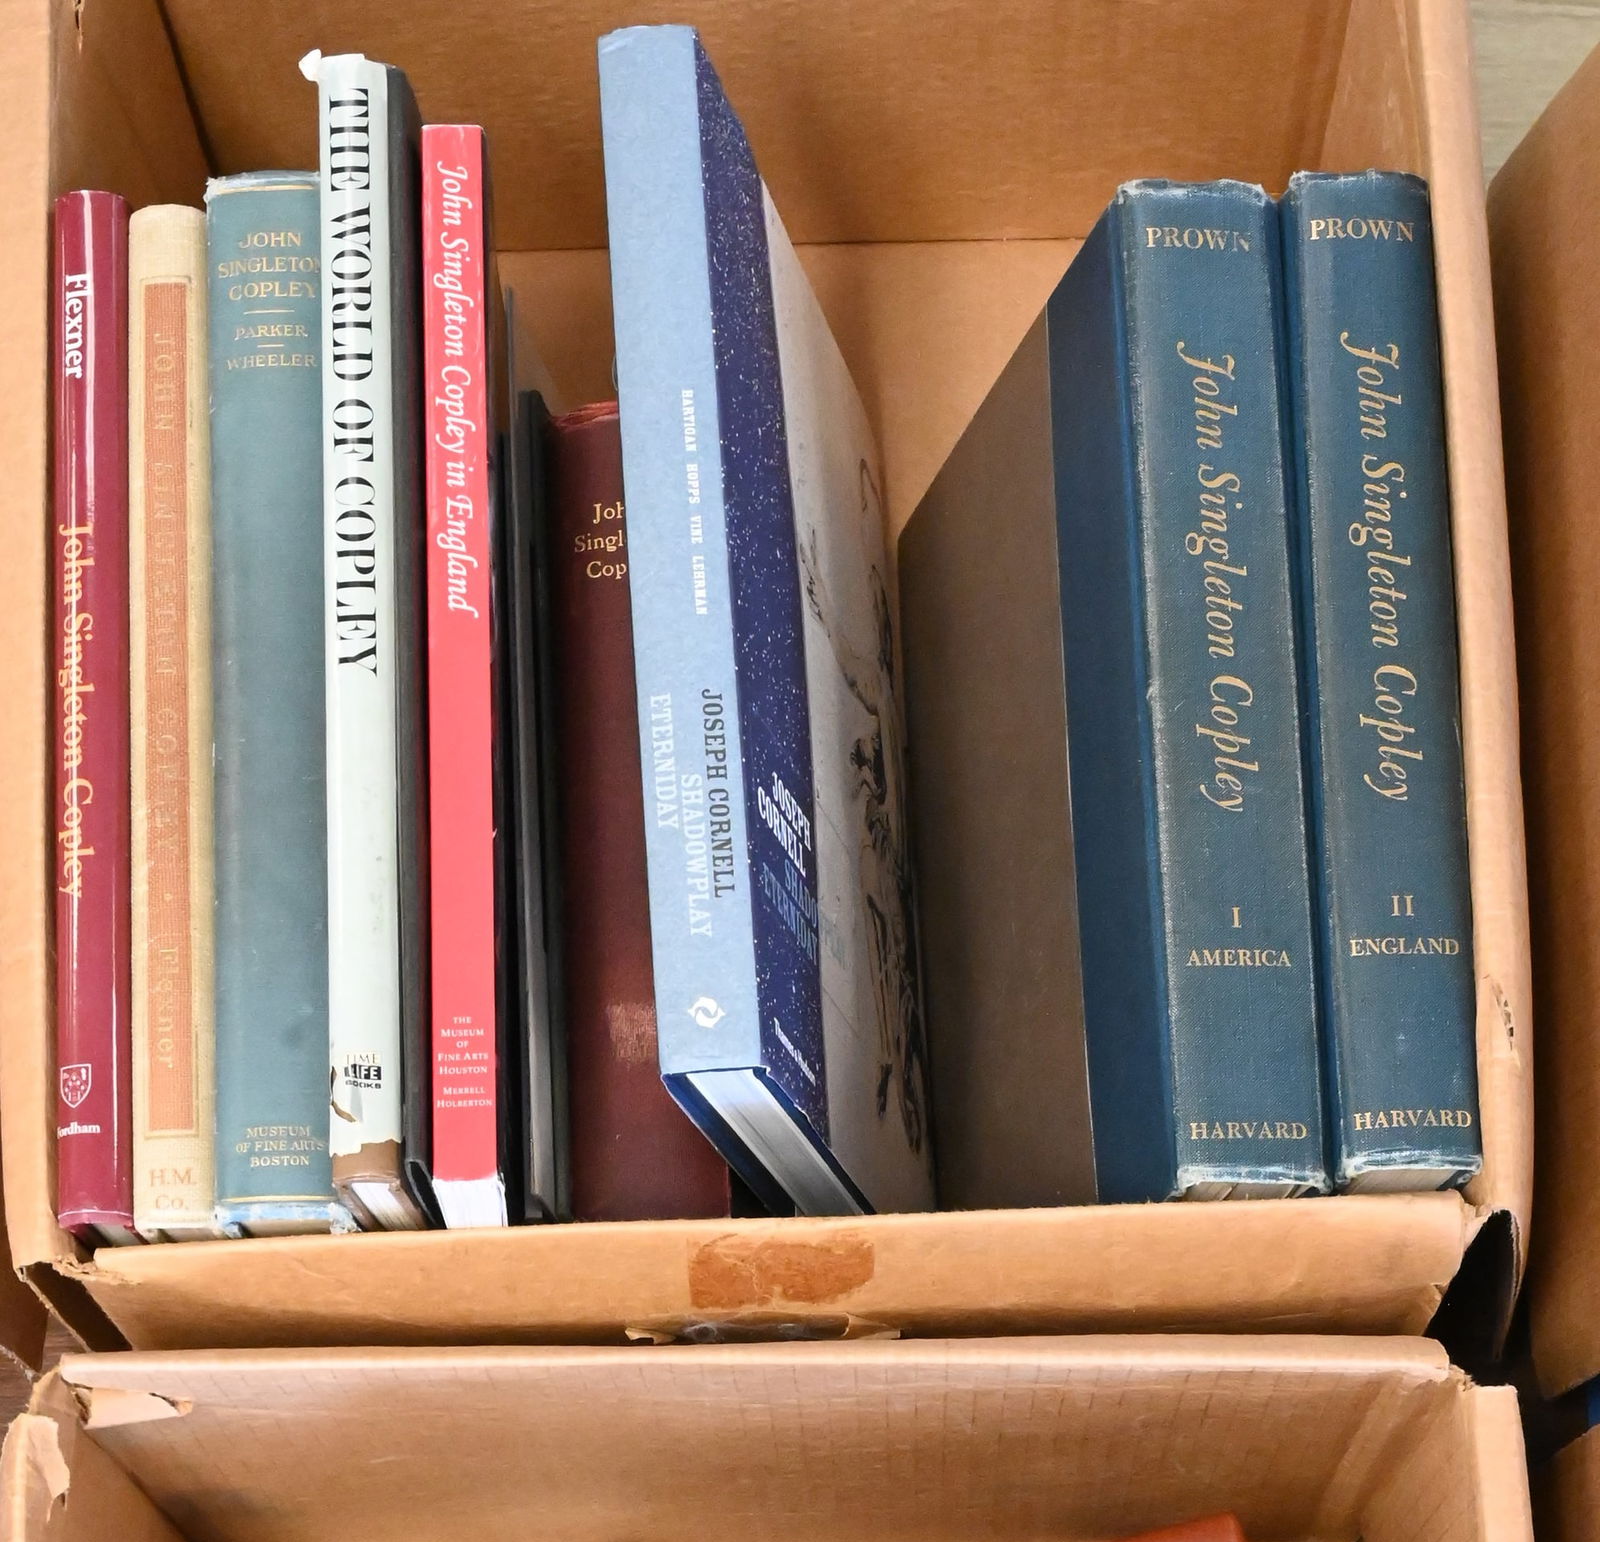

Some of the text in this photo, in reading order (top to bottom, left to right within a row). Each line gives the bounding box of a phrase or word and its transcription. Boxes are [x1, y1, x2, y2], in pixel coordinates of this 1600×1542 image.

[238, 232, 301, 249] JOHN
[1145, 226, 1251, 253] PROWN
[1309, 217, 1415, 243] PROWN
[229, 281, 316, 300] COPLEY
[65, 273, 92, 379] Flexner
[234, 325, 308, 341] PARKER
[227, 354, 317, 370] WHEELER
[328, 87, 378, 677] THE WORLD OF COPLEY
[433, 160, 478, 618] John Singleton Copley in England
[681, 389, 708, 615] HARTIGAN HOPPS VINE LEHRMAN
[593, 502, 625, 525] Joh
[574, 530, 625, 552] Singl
[586, 561, 627, 580] Cop
[1175, 340, 1260, 812] John Singleton Copley
[1339, 331, 1425, 802] John Singleton Copley
[58, 525, 95, 898] John Singleton Copley
[650, 693, 679, 829] ETERNIDAY
[701, 689, 735, 898] JOSEPH CORNELL
[772, 771, 812, 851] JOSEPH
[757, 786, 806, 877] CORNELL
[681, 774, 712, 937] SHADOWPLAY
[762, 862, 818, 966] ETERNIDAY
[1391, 894, 1415, 918] II
[1231, 906, 1242, 929] I
[1349, 937, 1461, 958] ENGLAND
[1185, 949, 1292, 968] AMERICA
[158, 948, 181, 1068] Flexner
[453, 1016, 472, 1024] THE
[440, 1028, 485, 1037] MUSEUM
[456, 1040, 470, 1048] OF
[437, 1052, 489, 1061] FINE ARTS
[344, 1064, 381, 1081] LIFE
[439, 1066, 488, 1075] HOUSTON
[345, 1079, 381, 1089] BOOKS
[442, 1086, 486, 1096] MERRELL
[436, 1099, 493, 1108] HOLBERTON
[1353, 1110, 1472, 1131] HARVARD
[246, 1125, 311, 1139] MUSEUM
[1189, 1122, 1308, 1141] HARVARD
[236, 1142, 250, 1153] OF
[255, 1140, 287, 1152] FINE
[250, 1155, 310, 1168] BOSTON
[149, 1168, 197, 1188] H.M.
[155, 1194, 189, 1211] Co.
